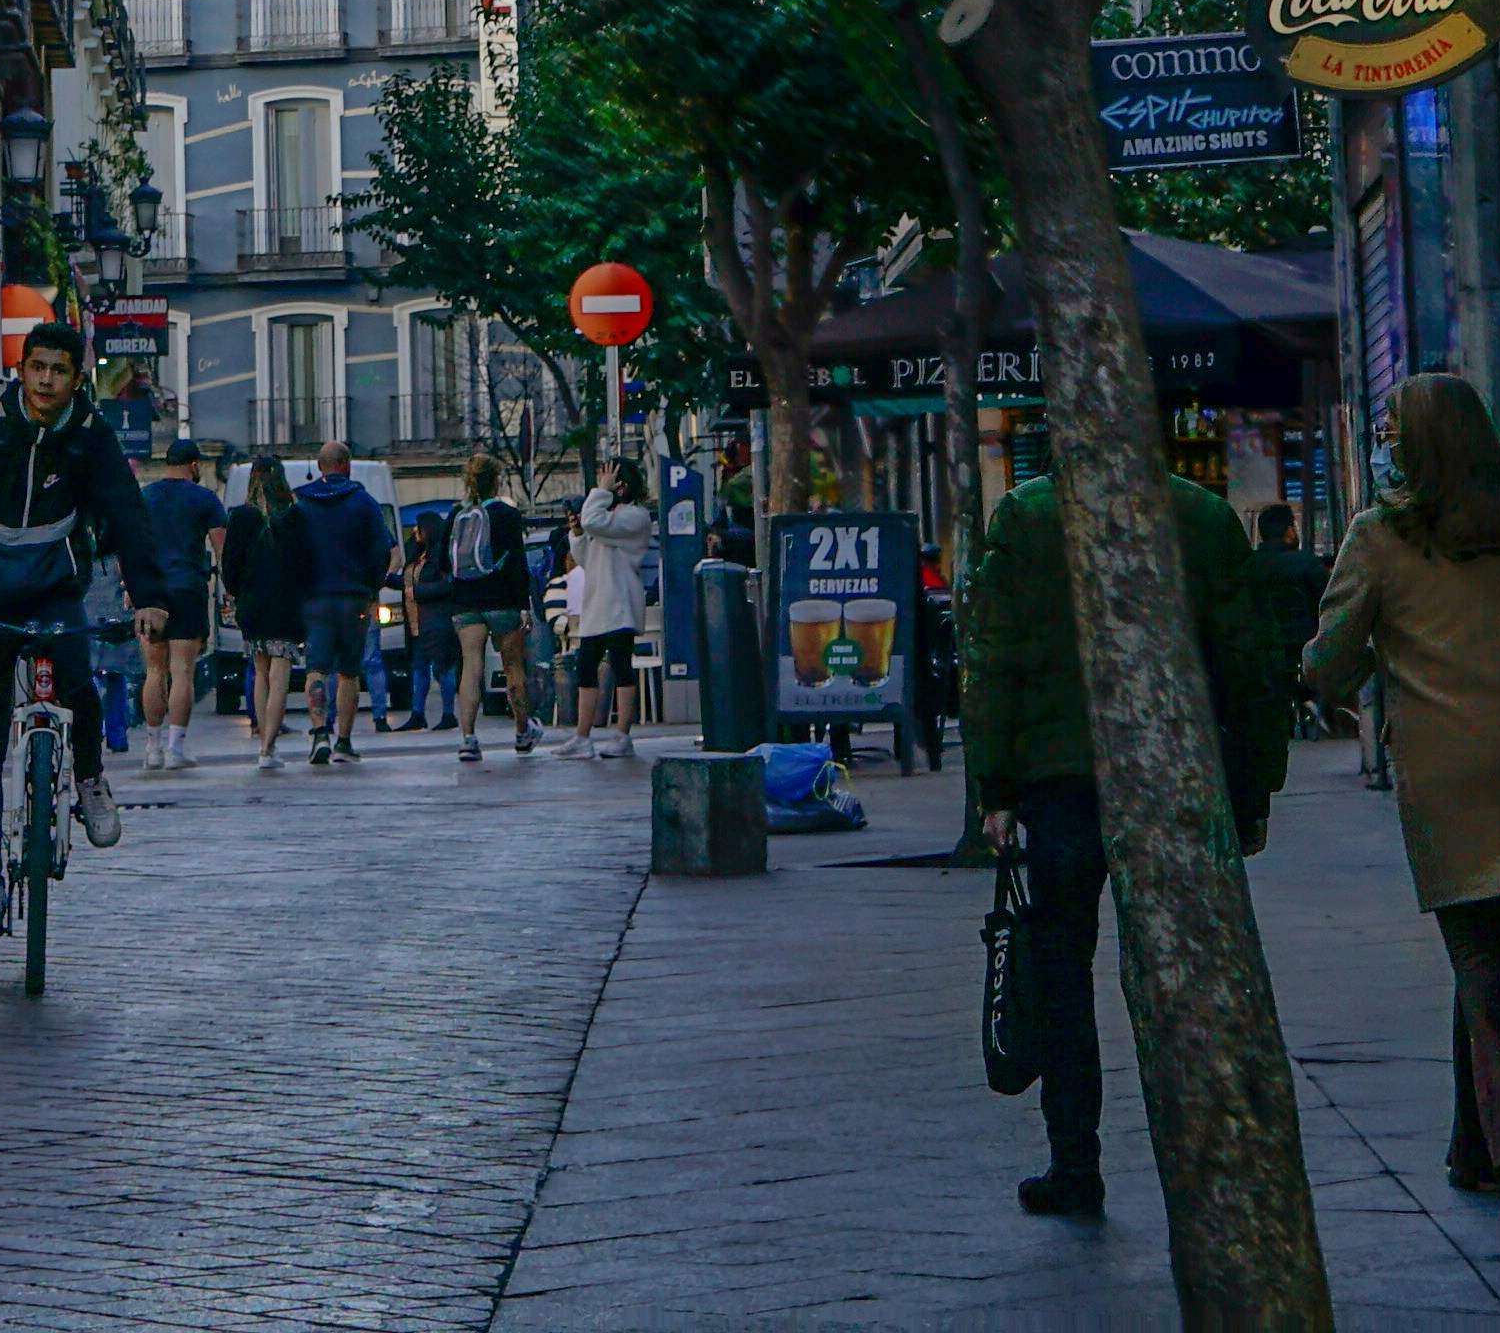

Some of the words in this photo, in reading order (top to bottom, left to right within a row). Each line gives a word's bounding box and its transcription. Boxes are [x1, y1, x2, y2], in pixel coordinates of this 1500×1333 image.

[1321, 55, 1343, 76] LA
[1354, 38, 1453, 82] TINTORERÍA
[1123, 133, 1206, 157] AMAZING
[1209, 129, 1268, 150] SHOTS
[106, 337, 157, 353] OBRERA
[730, 370, 760, 388] EL
[1171, 352, 1214, 369] 1983
[670, 466, 687, 488] P
[809, 526, 880, 571] 2X1
[809, 578, 879, 595] CERVEZAS
